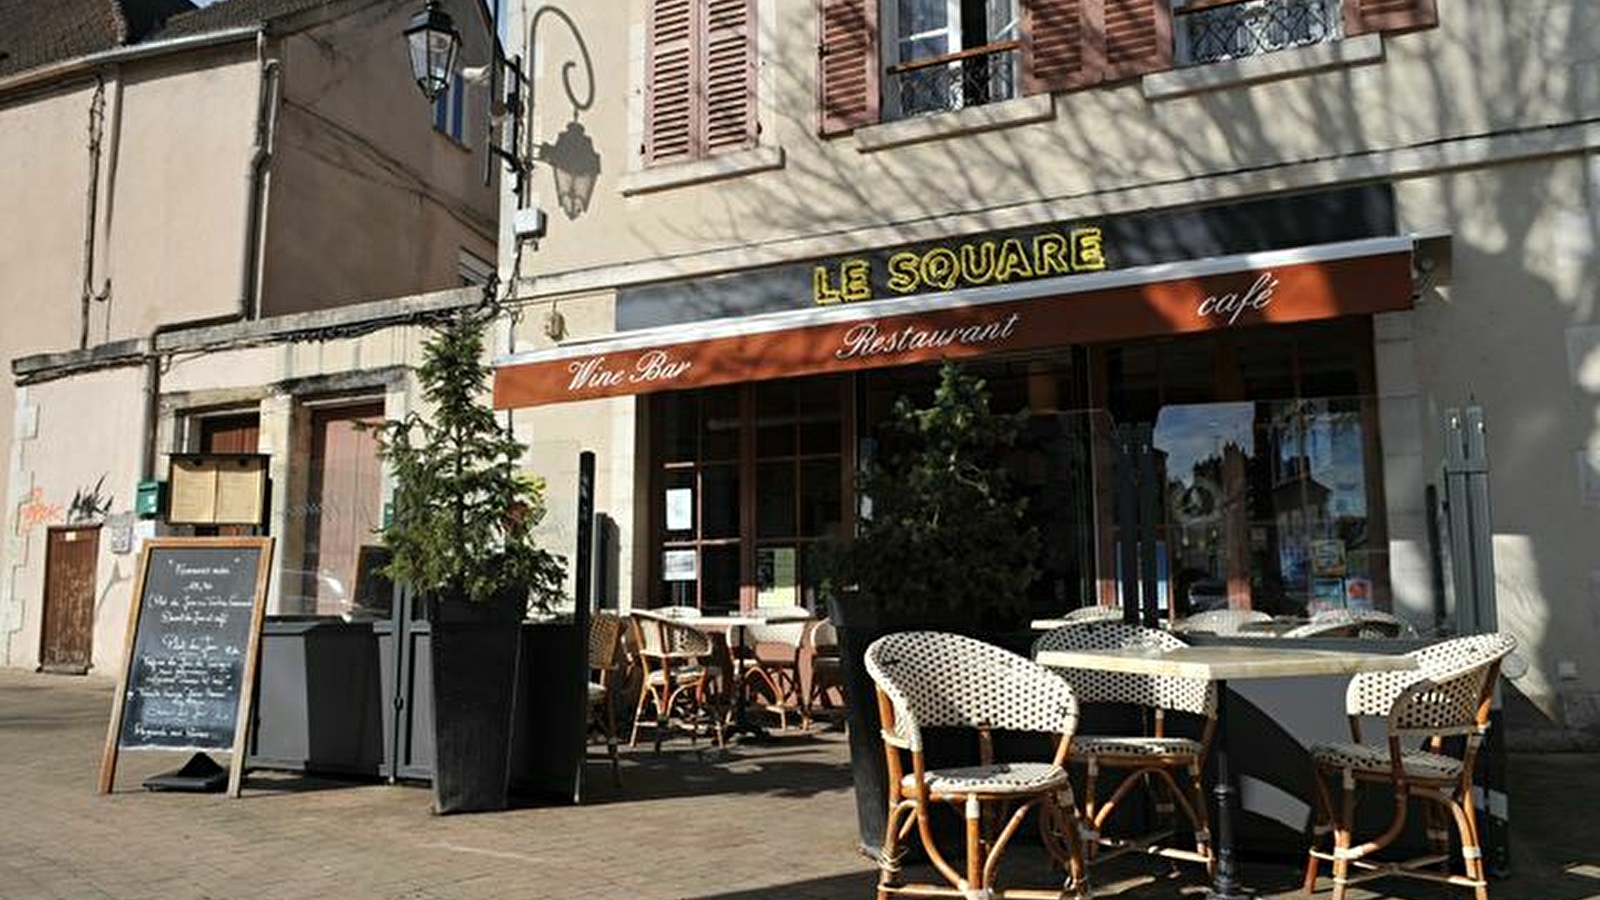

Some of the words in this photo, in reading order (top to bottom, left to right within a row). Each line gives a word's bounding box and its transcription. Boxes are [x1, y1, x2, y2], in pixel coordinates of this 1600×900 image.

[814, 259, 870, 304] LE
[888, 228, 1105, 289] SQUARE
[568, 356, 625, 390] Wine
[629, 350, 691, 383] Bar
[835, 311, 1019, 358] Restaurant
[1197, 272, 1278, 325] café
